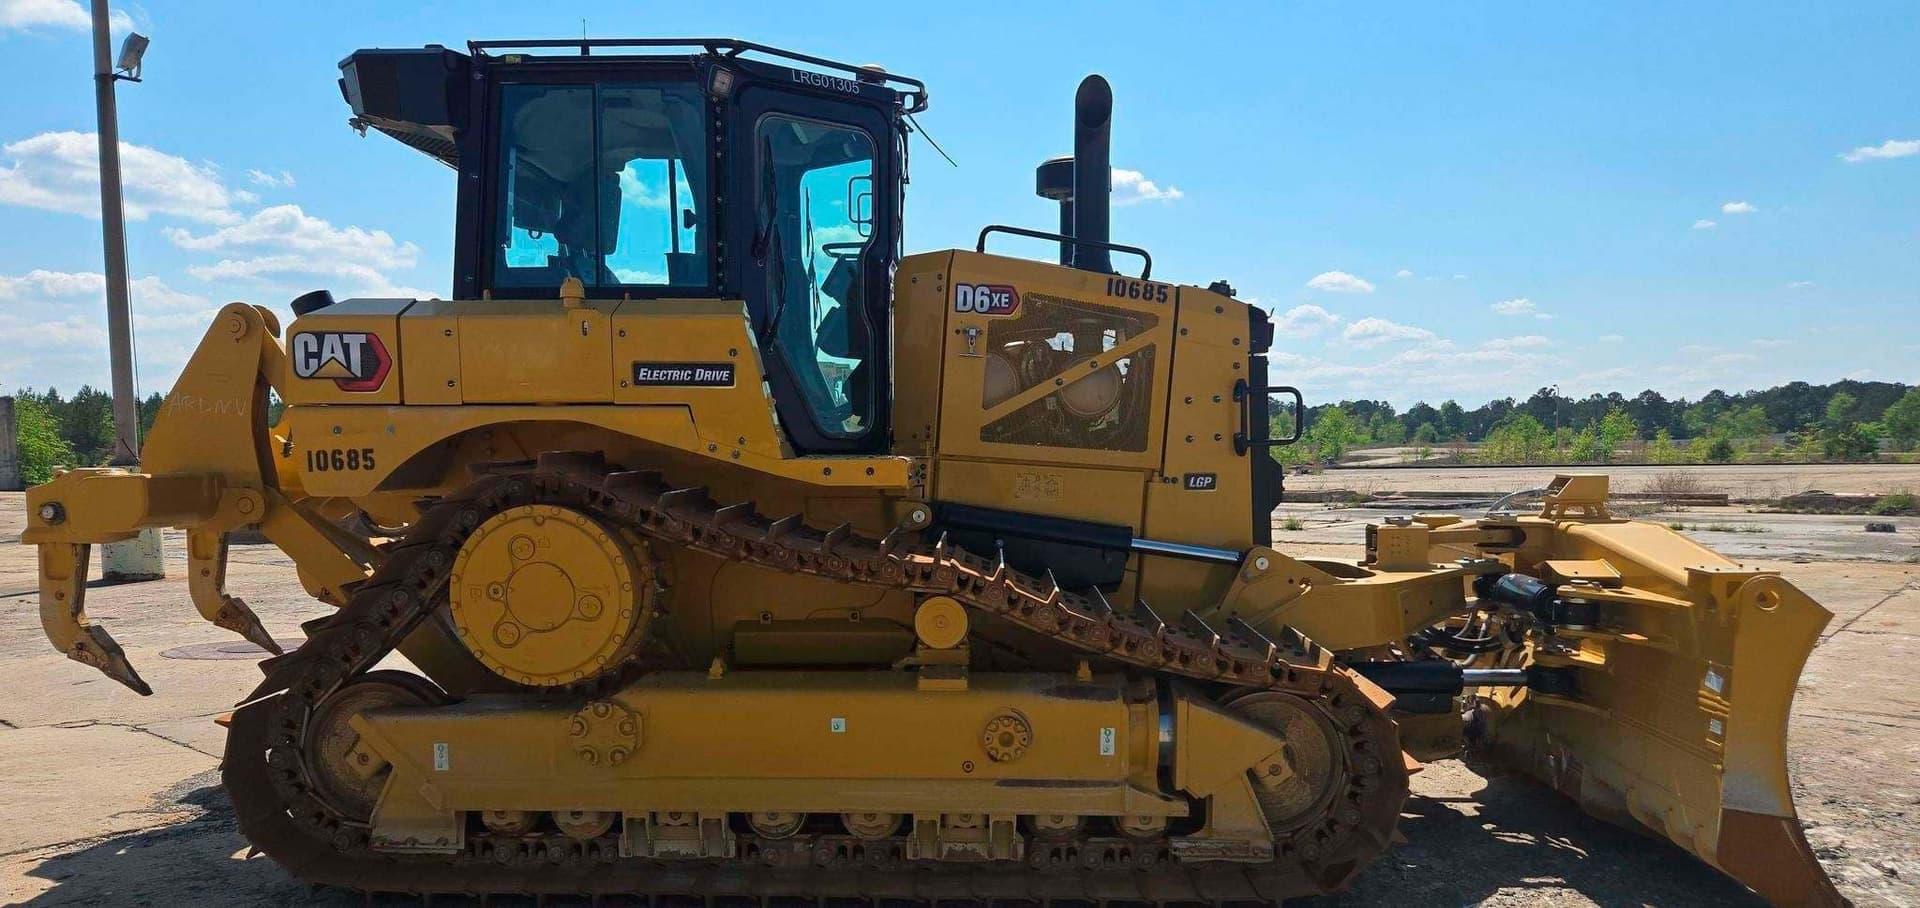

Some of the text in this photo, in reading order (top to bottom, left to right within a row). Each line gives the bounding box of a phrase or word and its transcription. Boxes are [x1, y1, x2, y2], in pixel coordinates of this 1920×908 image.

[792, 69, 860, 94] LRG01305
[1107, 278, 1168, 304] 10685
[294, 333, 367, 378] CAT
[638, 367, 730, 381] ELECTRIC DRIVE
[307, 448, 376, 472] 10685
[1189, 476, 1212, 488] LGP
